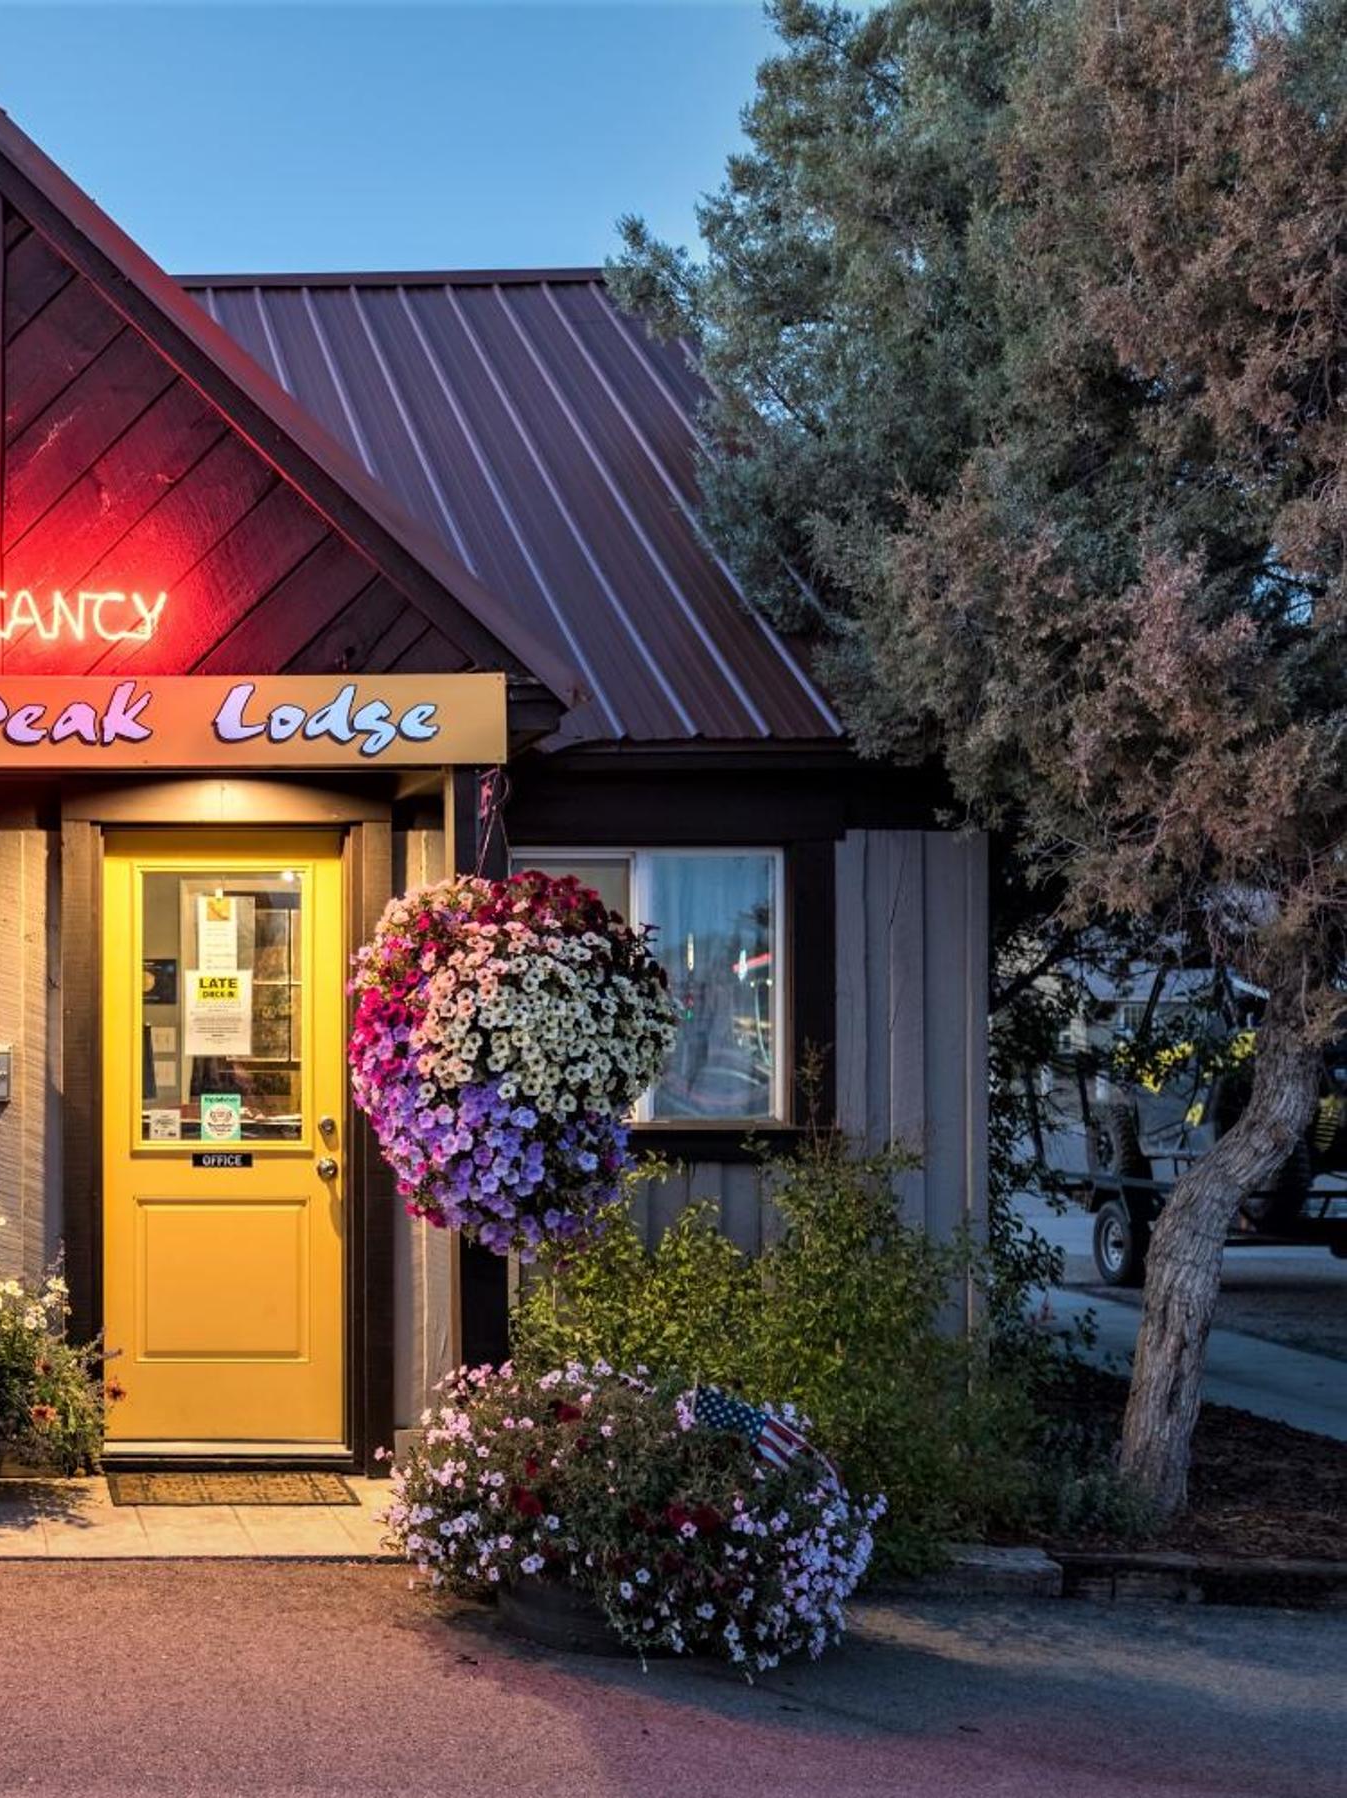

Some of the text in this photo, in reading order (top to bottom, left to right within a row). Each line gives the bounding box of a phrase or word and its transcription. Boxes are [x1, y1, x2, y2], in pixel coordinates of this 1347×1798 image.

[213, 682, 440, 757] Lodge
[199, 977, 238, 989] LATE
[202, 1154, 243, 1167] OFFICE
